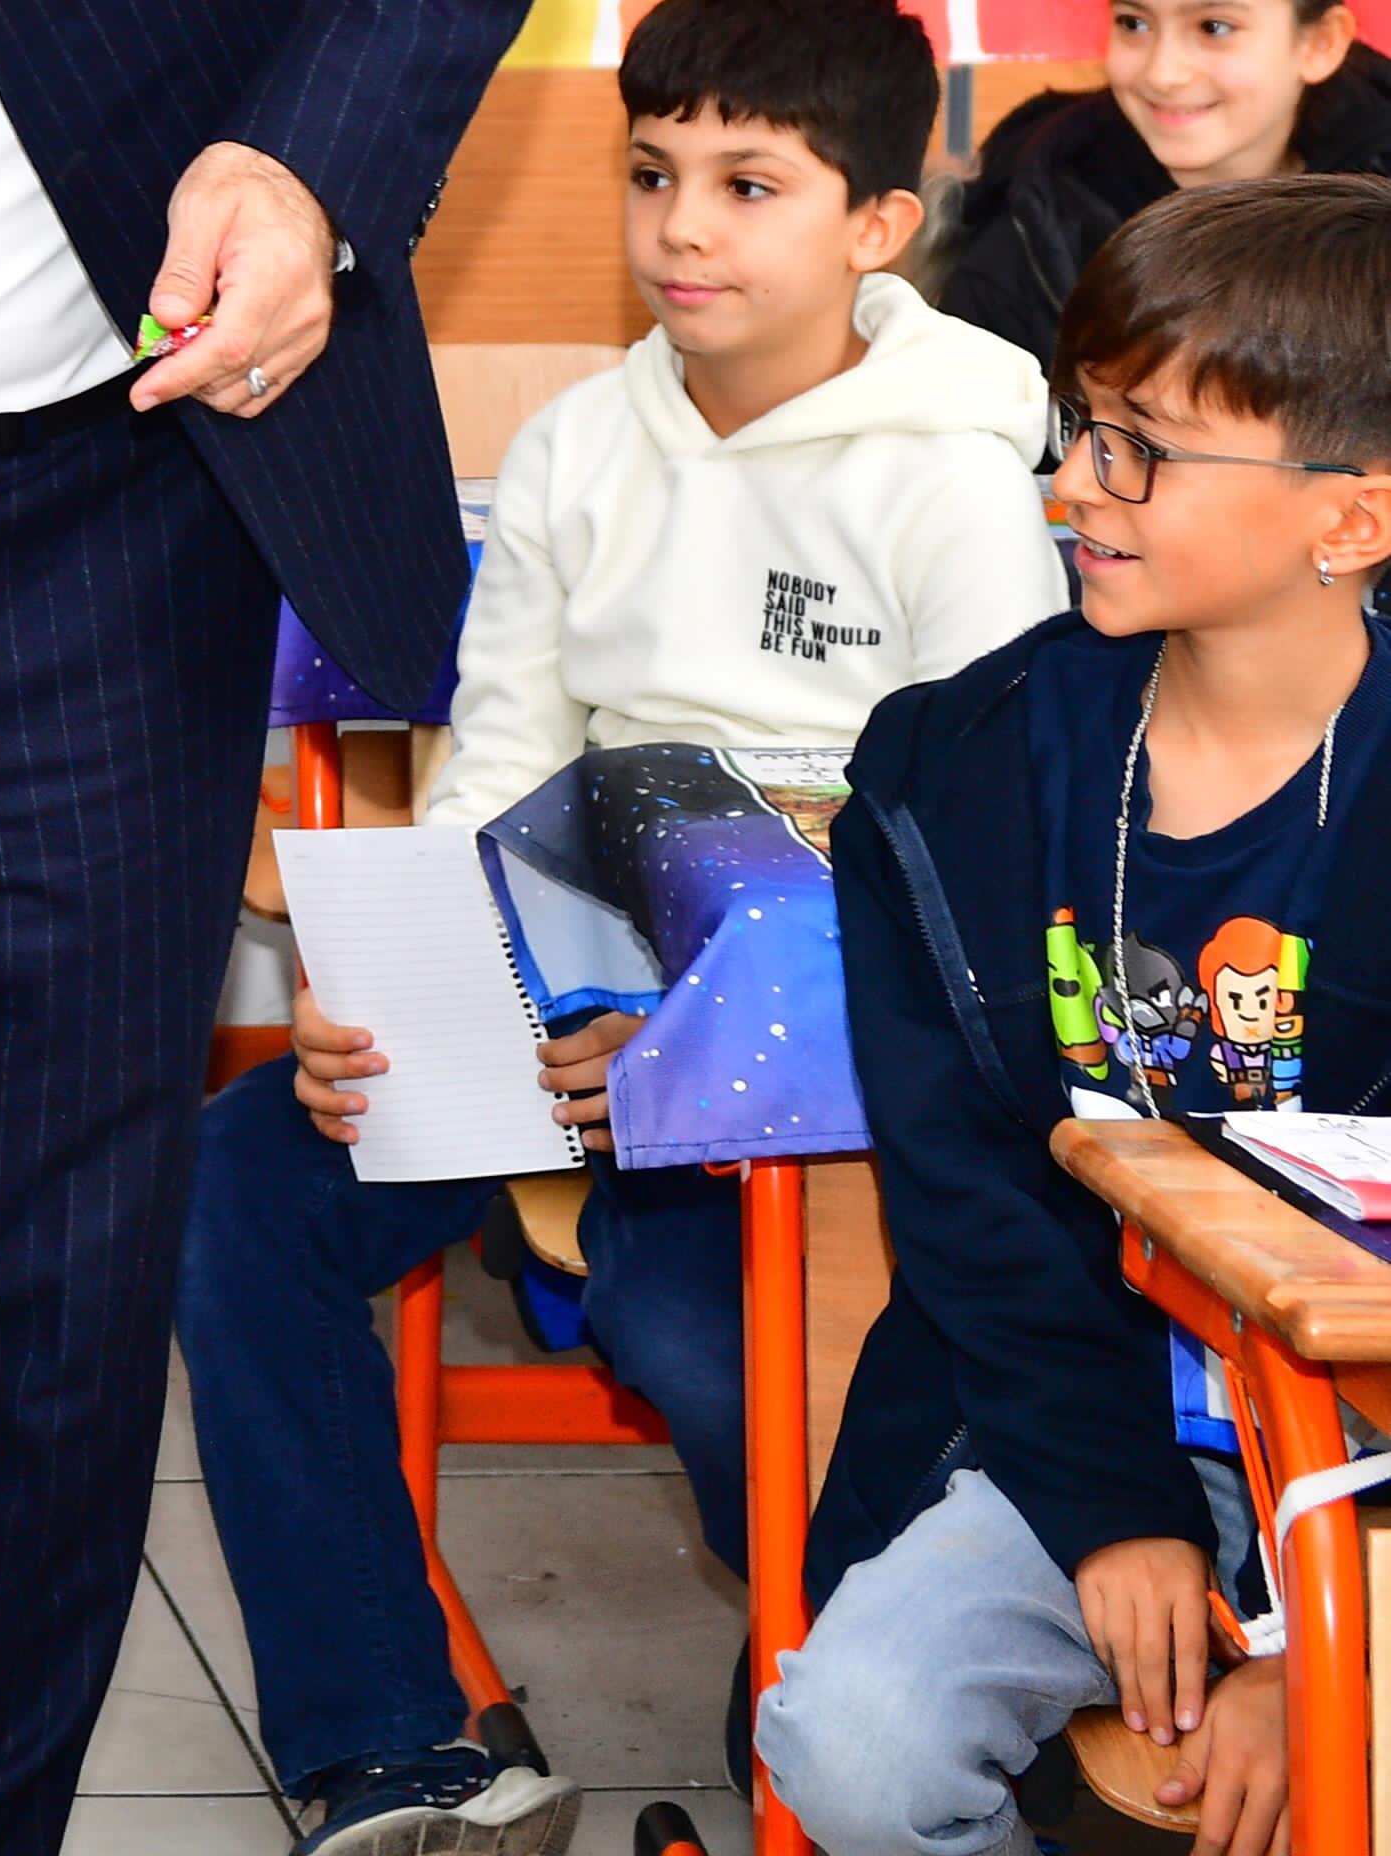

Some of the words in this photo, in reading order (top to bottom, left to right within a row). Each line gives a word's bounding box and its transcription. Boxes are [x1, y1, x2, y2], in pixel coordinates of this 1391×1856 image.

[765, 590, 806, 617] SAID
[767, 568, 837, 605] NOBODY
[762, 609, 804, 637] THIS
[811, 620, 882, 646] WOULD
[760, 630, 785, 654] BE
[791, 637, 826, 663] FUN
